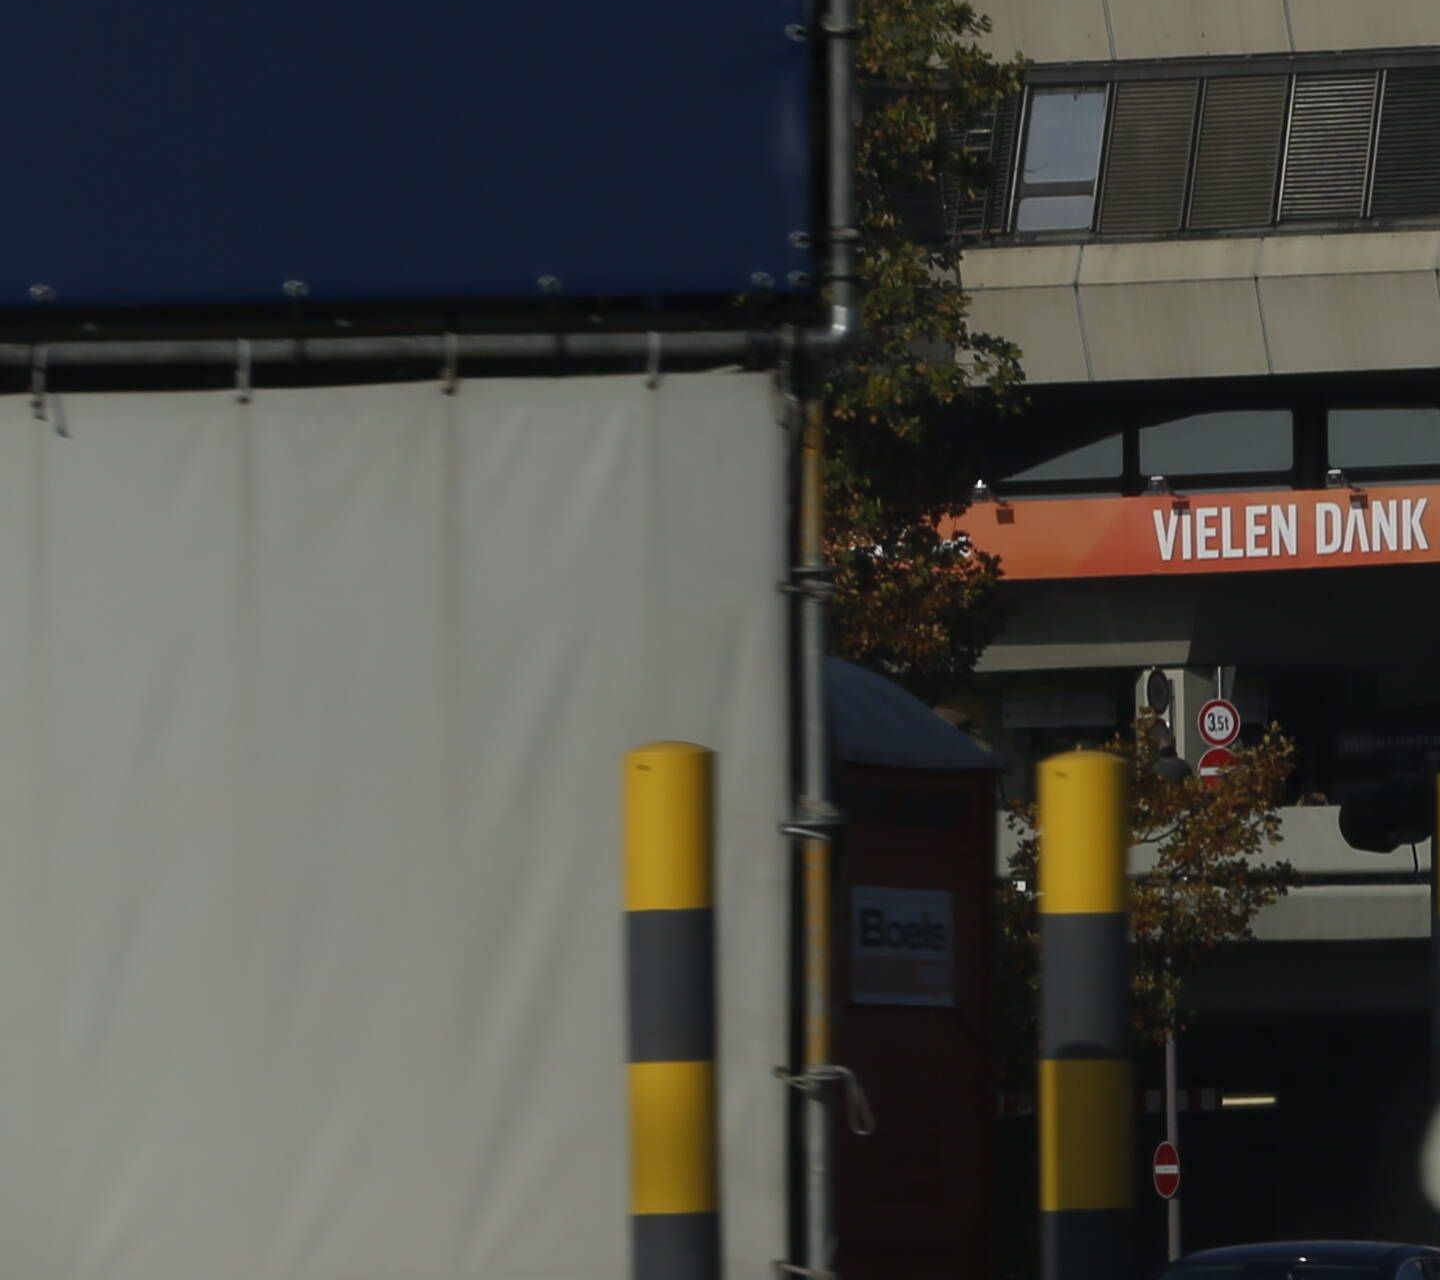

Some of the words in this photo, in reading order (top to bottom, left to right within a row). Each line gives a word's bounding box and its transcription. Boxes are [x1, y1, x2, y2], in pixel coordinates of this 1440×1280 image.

[1153, 503, 1298, 561] VIELEN
[1314, 498, 1429, 555] DANK
[860, 907, 946, 950] Boels
